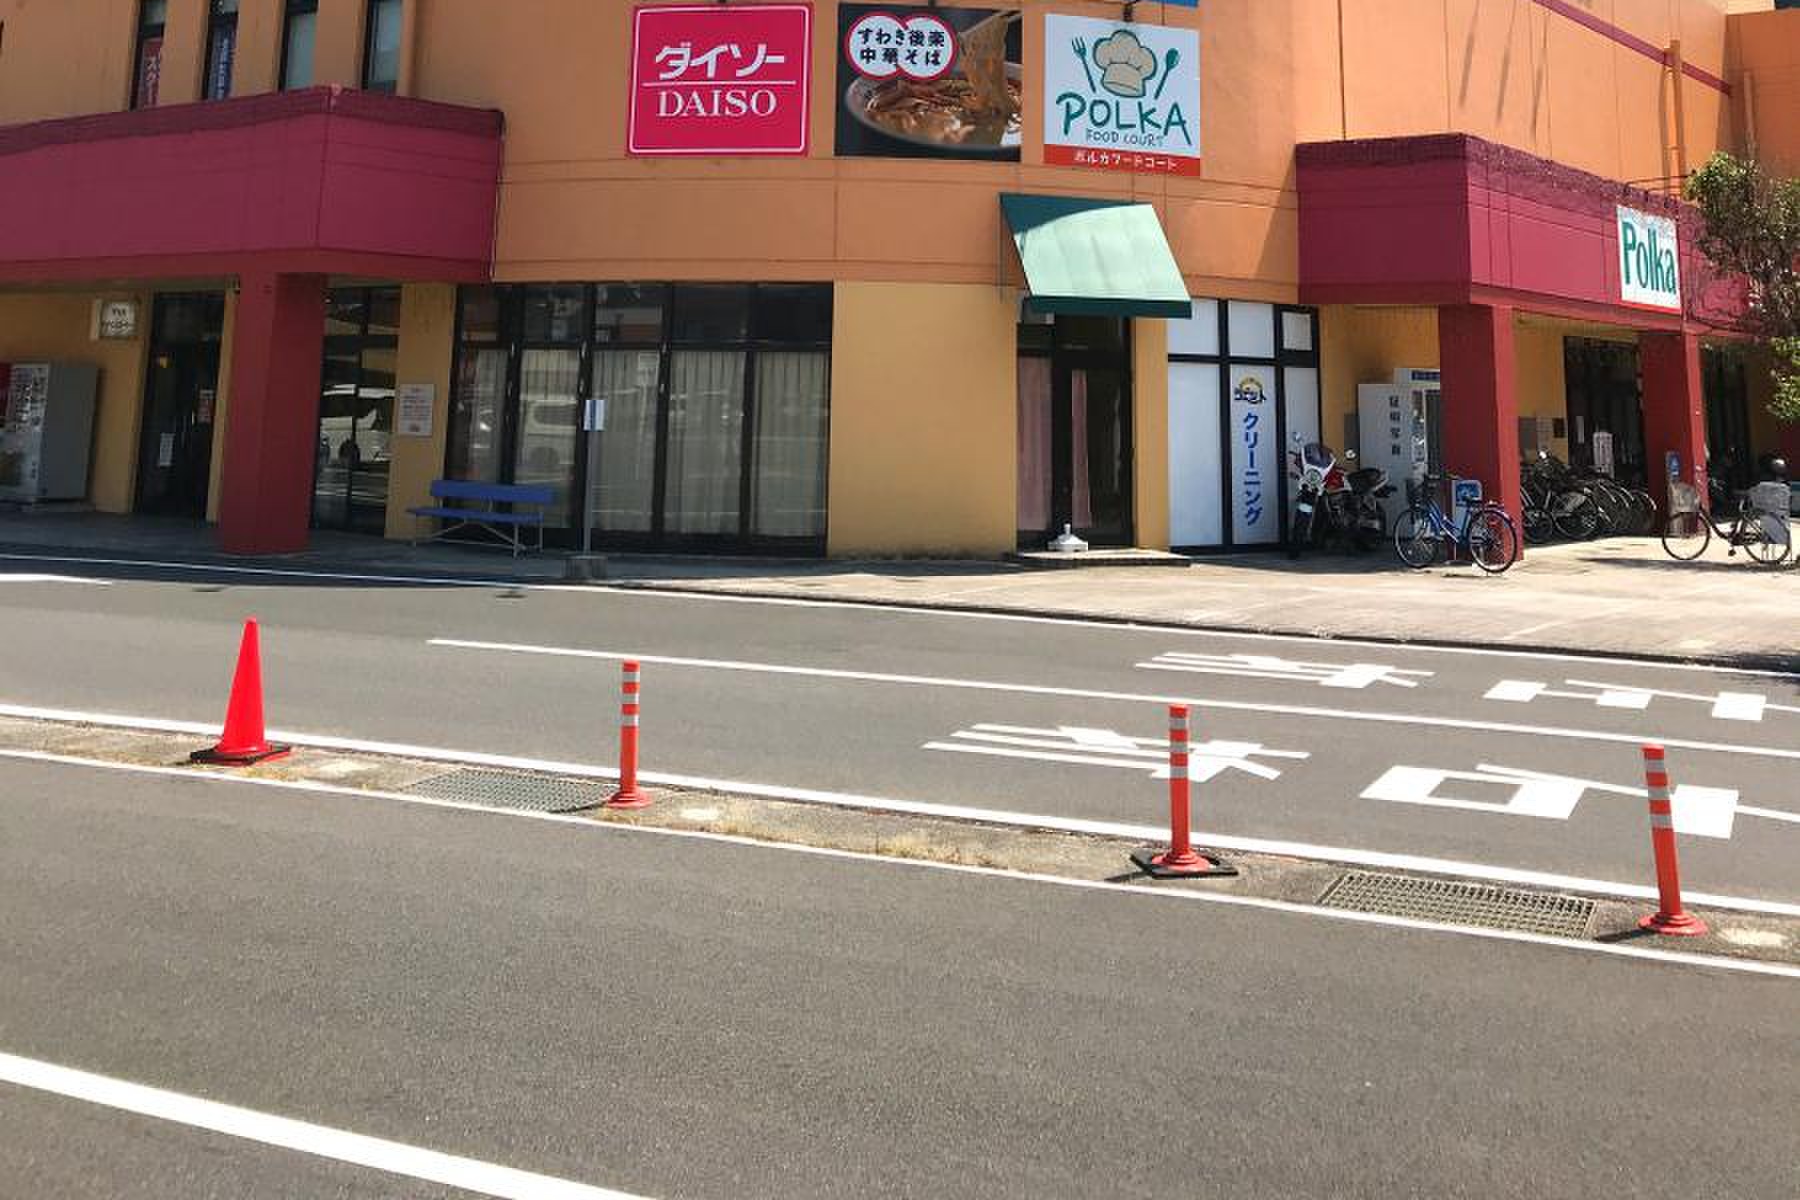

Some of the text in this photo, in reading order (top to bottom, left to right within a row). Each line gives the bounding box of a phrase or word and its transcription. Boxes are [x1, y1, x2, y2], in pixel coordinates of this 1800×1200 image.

[655, 42, 785, 80] ダイソー
[861, 47, 941, 66] 中華そば
[656, 90, 777, 117] DAISO
[1055, 92, 1193, 146] POLKA
[1087, 128, 1120, 143] FOOD
[1622, 221, 1677, 295] Polka
[1243, 412, 1263, 527] クリーニング
